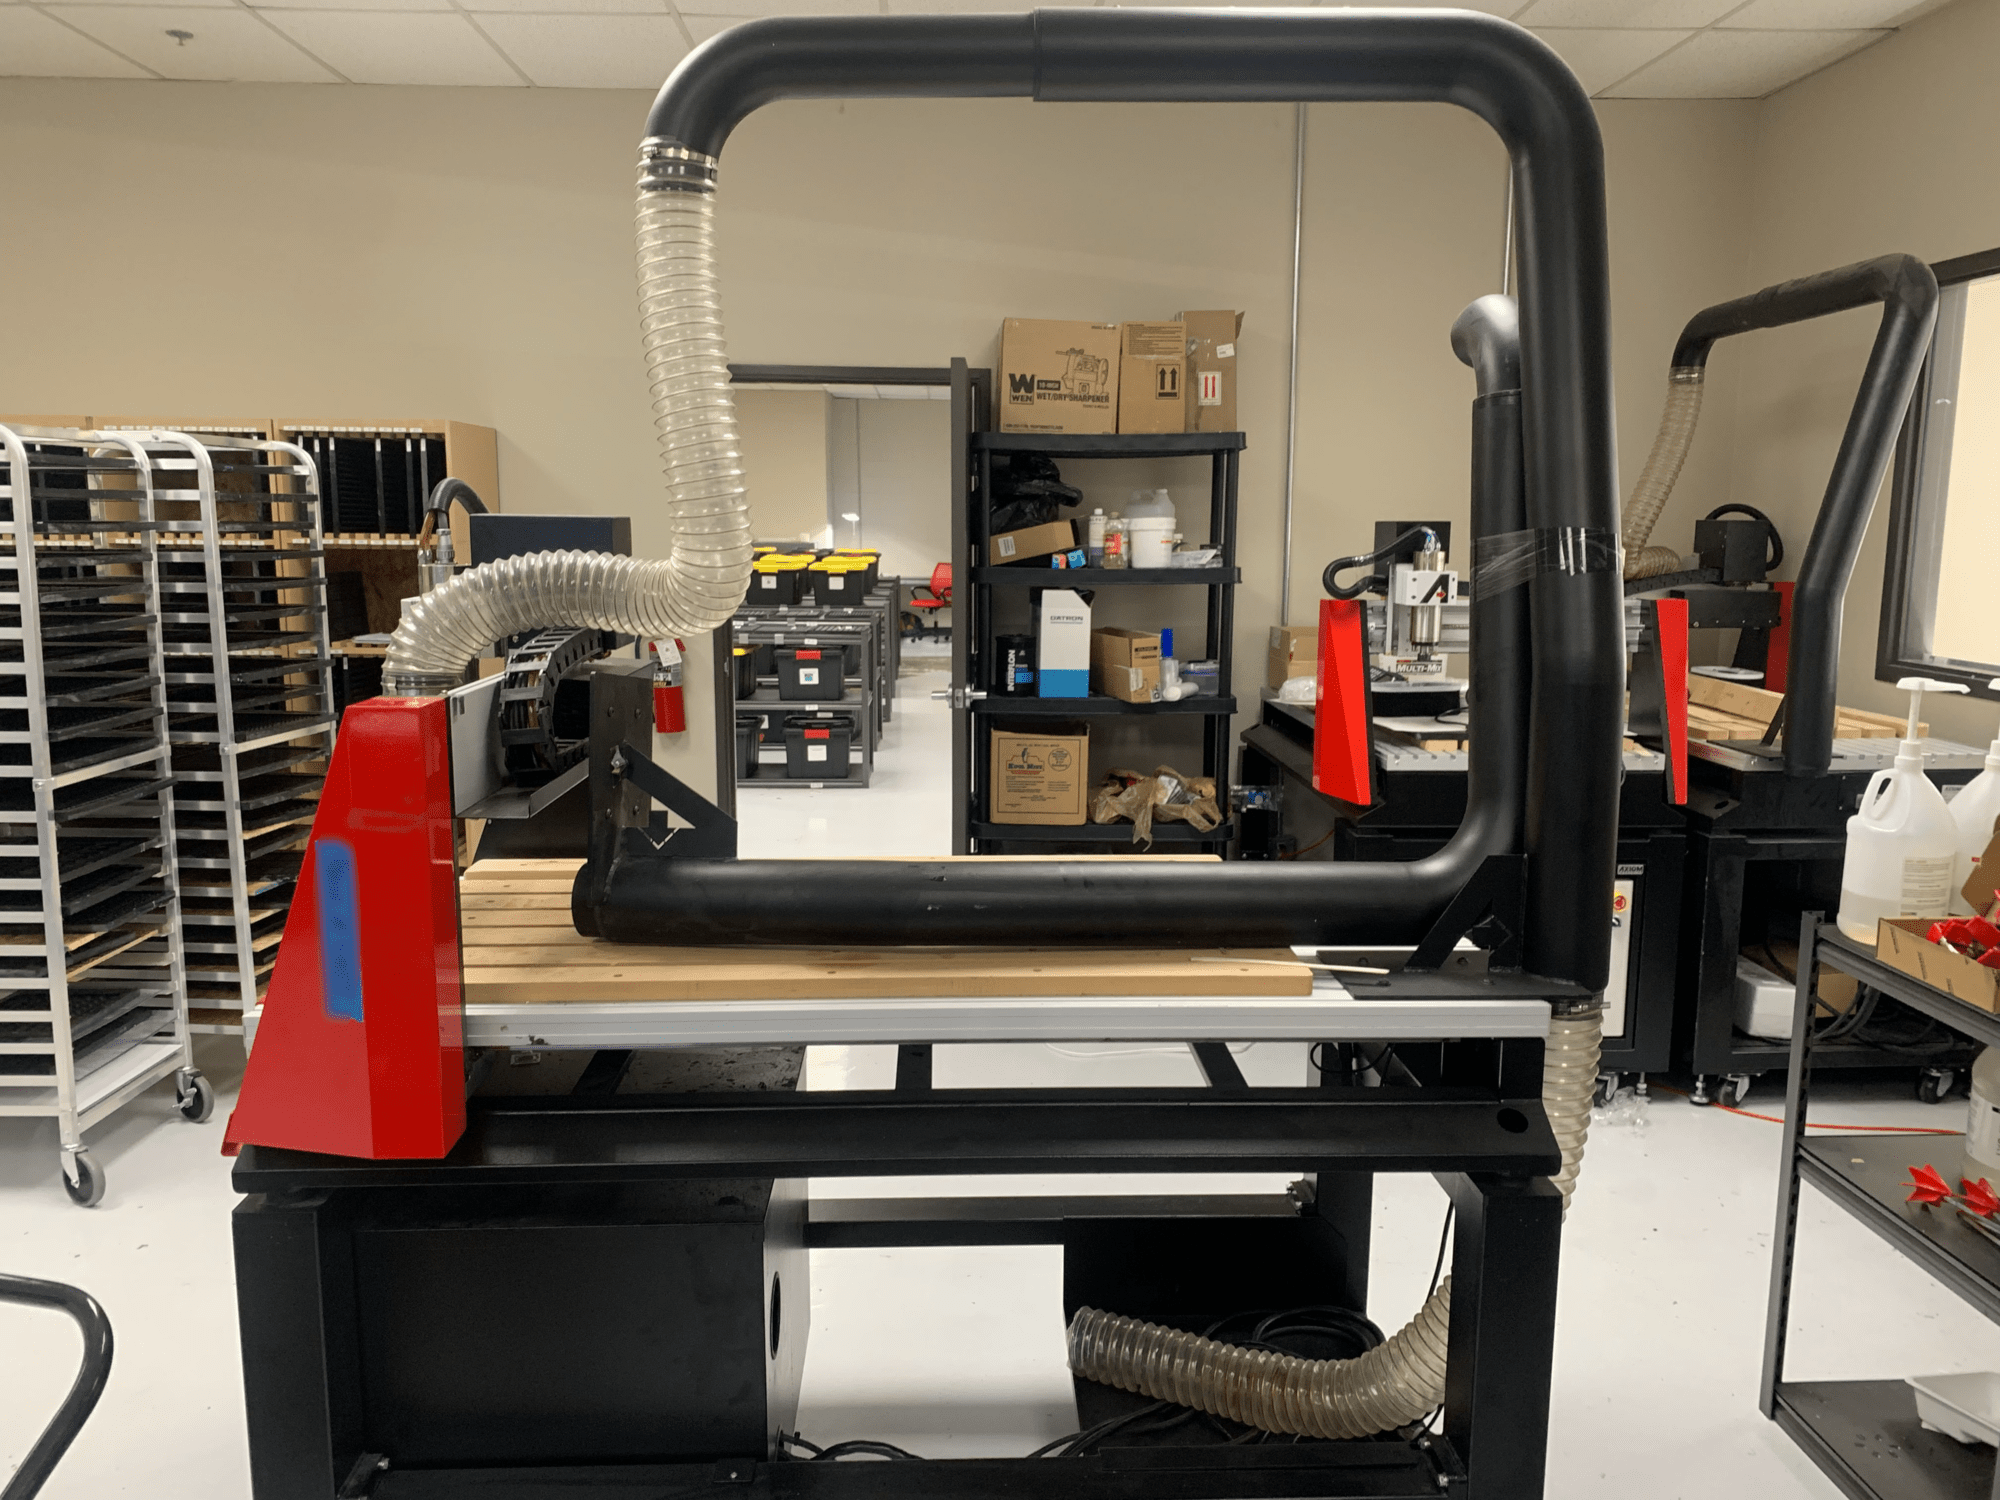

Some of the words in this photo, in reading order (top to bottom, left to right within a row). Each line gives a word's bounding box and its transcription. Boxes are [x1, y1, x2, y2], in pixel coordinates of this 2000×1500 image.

[1012, 394, 1033, 402] WEN
[1037, 392, 1067, 401] WET/DRY
[1069, 393, 1110, 403] SHARPENER
[1007, 649, 1016, 692] INTERFLON
[1619, 865, 1643, 873] AXIOM
